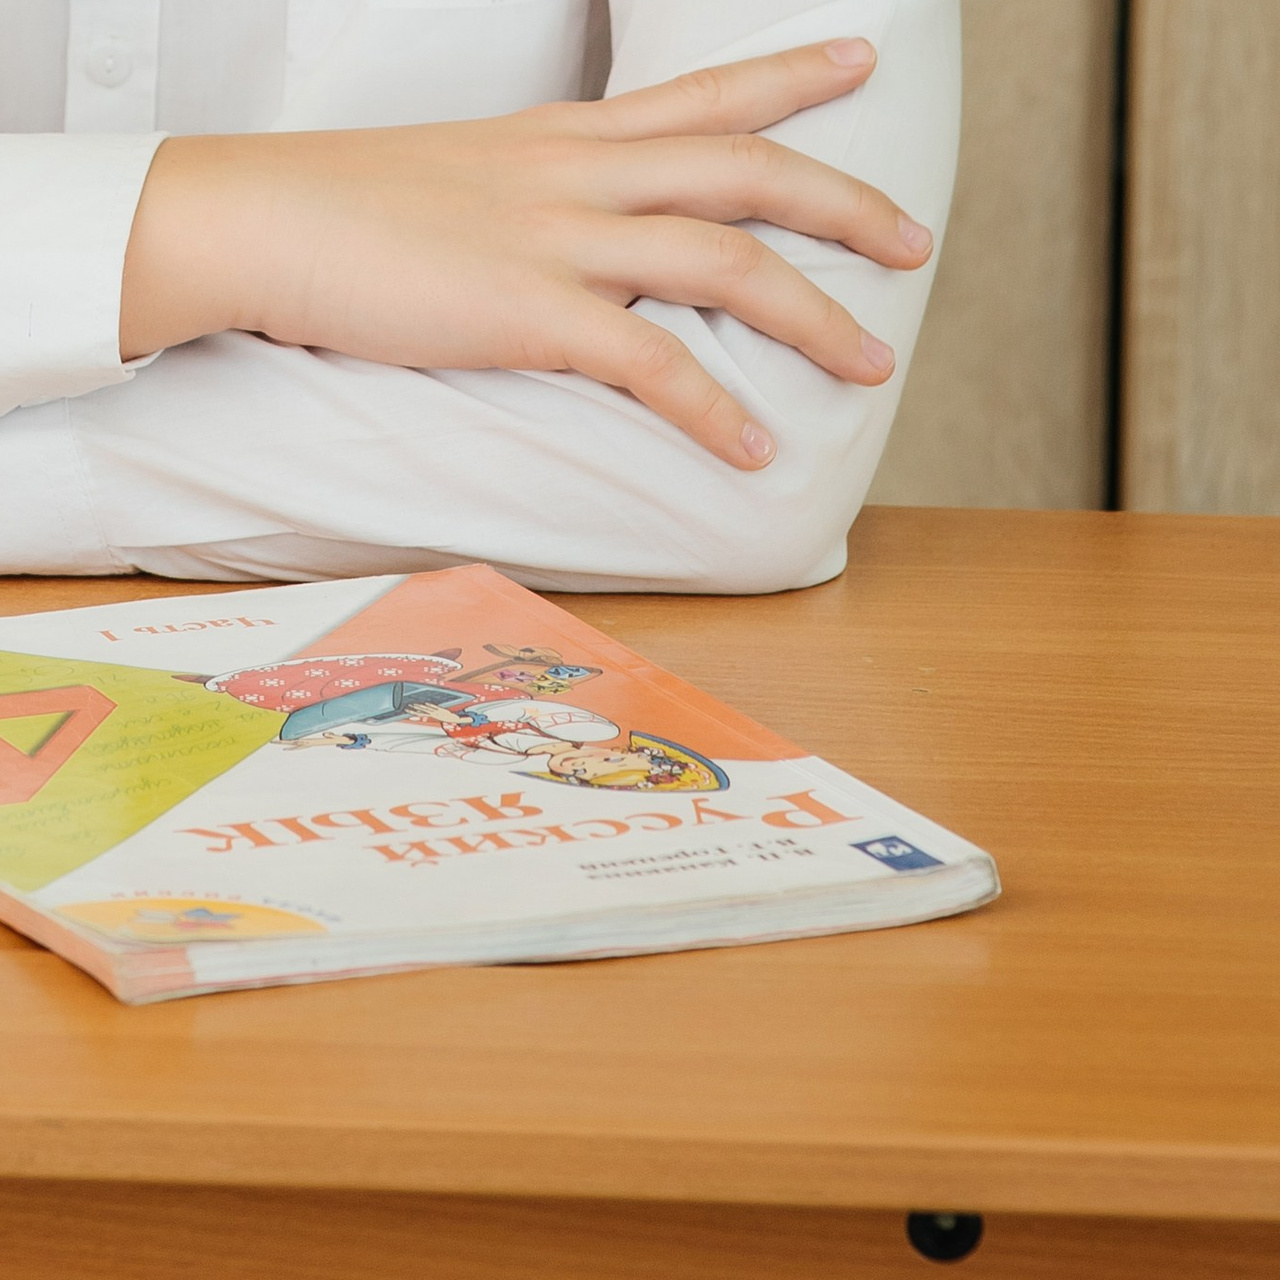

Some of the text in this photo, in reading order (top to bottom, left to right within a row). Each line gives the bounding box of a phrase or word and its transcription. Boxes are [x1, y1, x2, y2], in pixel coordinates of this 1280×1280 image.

[96, 616, 280, 642] Часть 1
[362, 789, 863, 867] Русский
